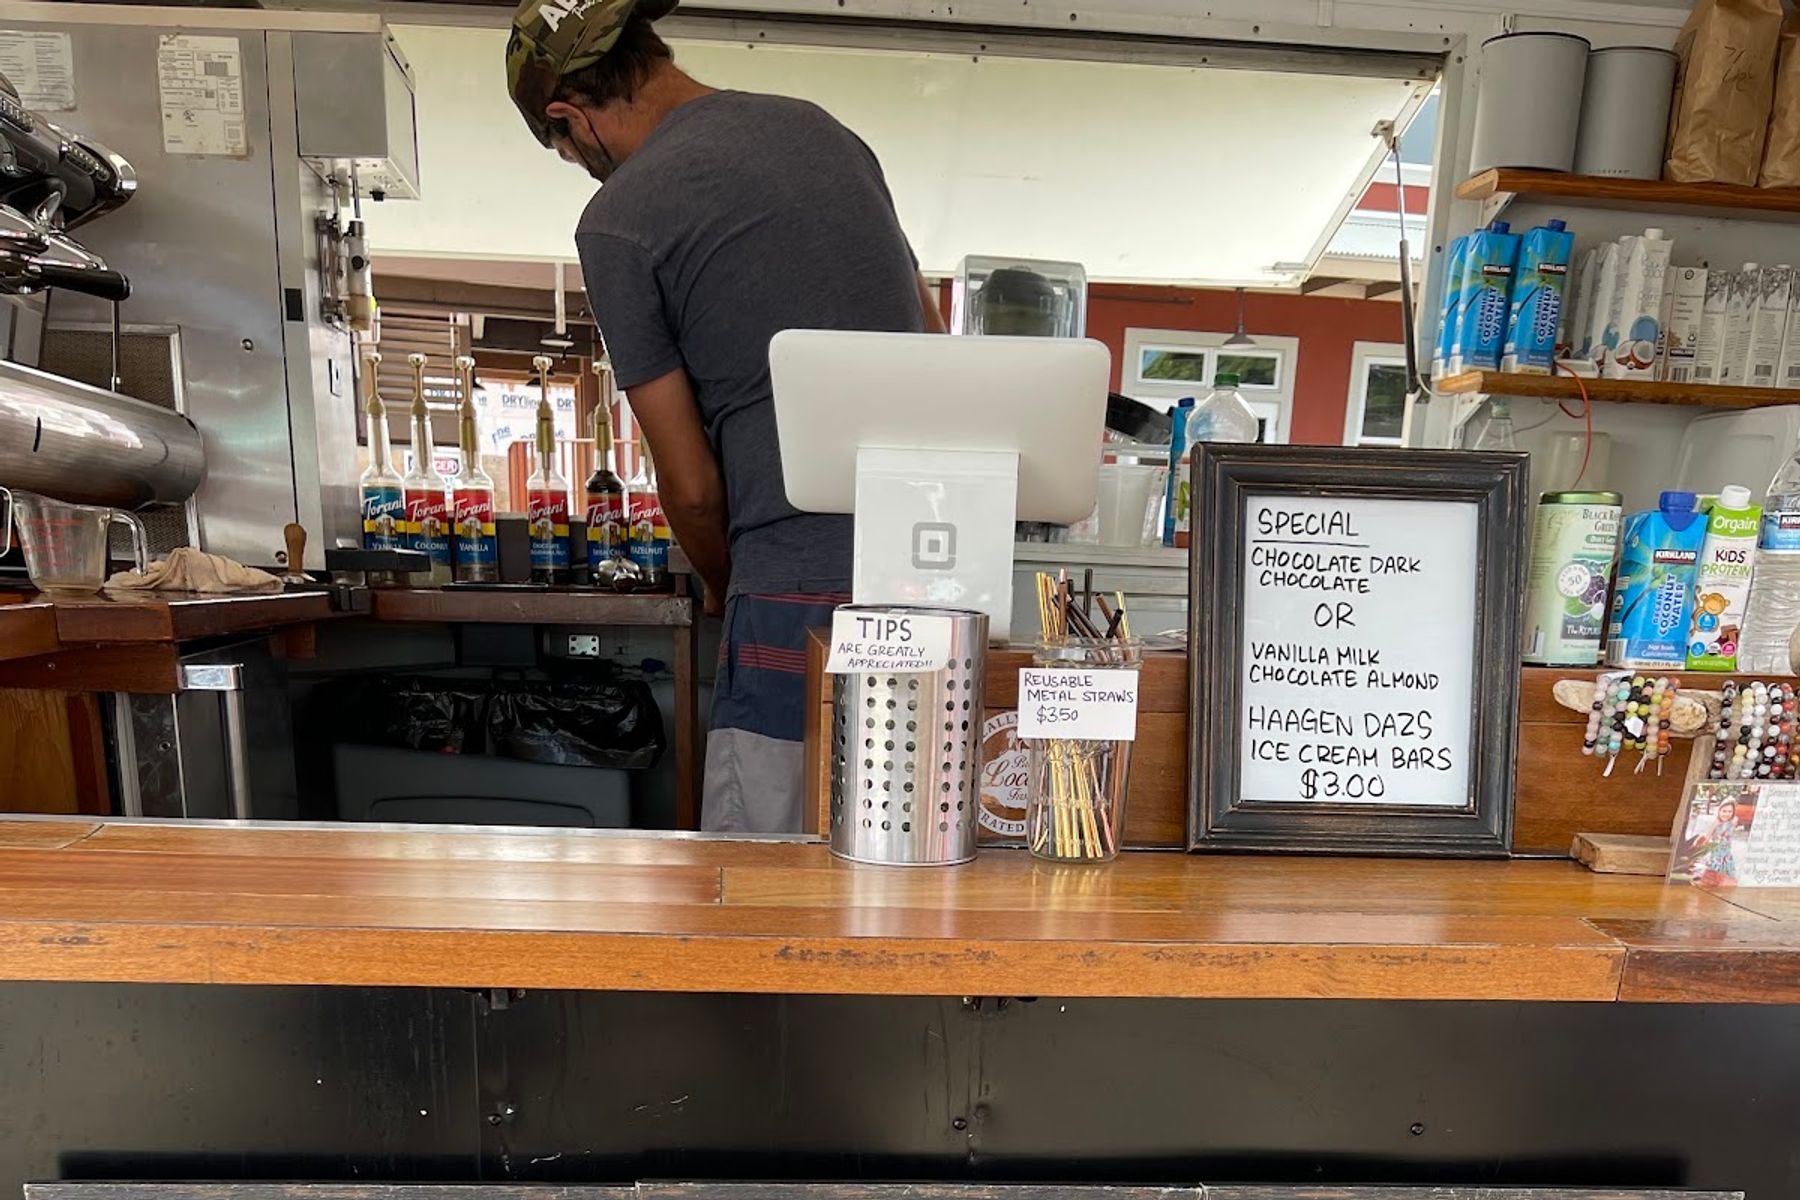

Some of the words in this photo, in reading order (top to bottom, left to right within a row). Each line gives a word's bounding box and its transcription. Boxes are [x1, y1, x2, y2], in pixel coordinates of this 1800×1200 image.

[454, 498, 490, 523] Torani
[1259, 509, 1358, 536] SPECIAL
[1713, 516, 1757, 533] Orgain
[459, 543, 489, 552] VANILLA
[1655, 551, 1696, 560] KIRKLAND
[1715, 549, 1746, 564] KIDS
[1252, 547, 1361, 573] CHOCOLATE
[1371, 557, 1420, 574] DARK
[1702, 564, 1750, 577] PROTEIN
[1260, 570, 1370, 593] CHOCOLATE
[1315, 602, 1355, 629] OR
[1659, 574, 1675, 635] COCONUT
[1670, 585, 1684, 627] WATER
[857, 617, 911, 641] TIPS
[838, 643, 862, 654] ARE
[868, 645, 925, 657] GREATLY
[1252, 643, 1328, 664] VANILLA
[1337, 647, 1379, 665] MILK
[1025, 672, 1092, 688] REUSABLE
[1250, 665, 1357, 687] CHOCOLATE
[1368, 670, 1438, 689] ALMOND
[1028, 690, 1075, 701] METAL
[1083, 690, 1133, 703] STRAWS
[1250, 706, 1352, 736] HAAGEN
[1364, 711, 1432, 739] DAZS
[1252, 739, 1289, 761] ICE
[1299, 745, 1377, 766] CREAM
[1392, 747, 1451, 770] BARS
[1301, 769, 1384, 799] $3.00
